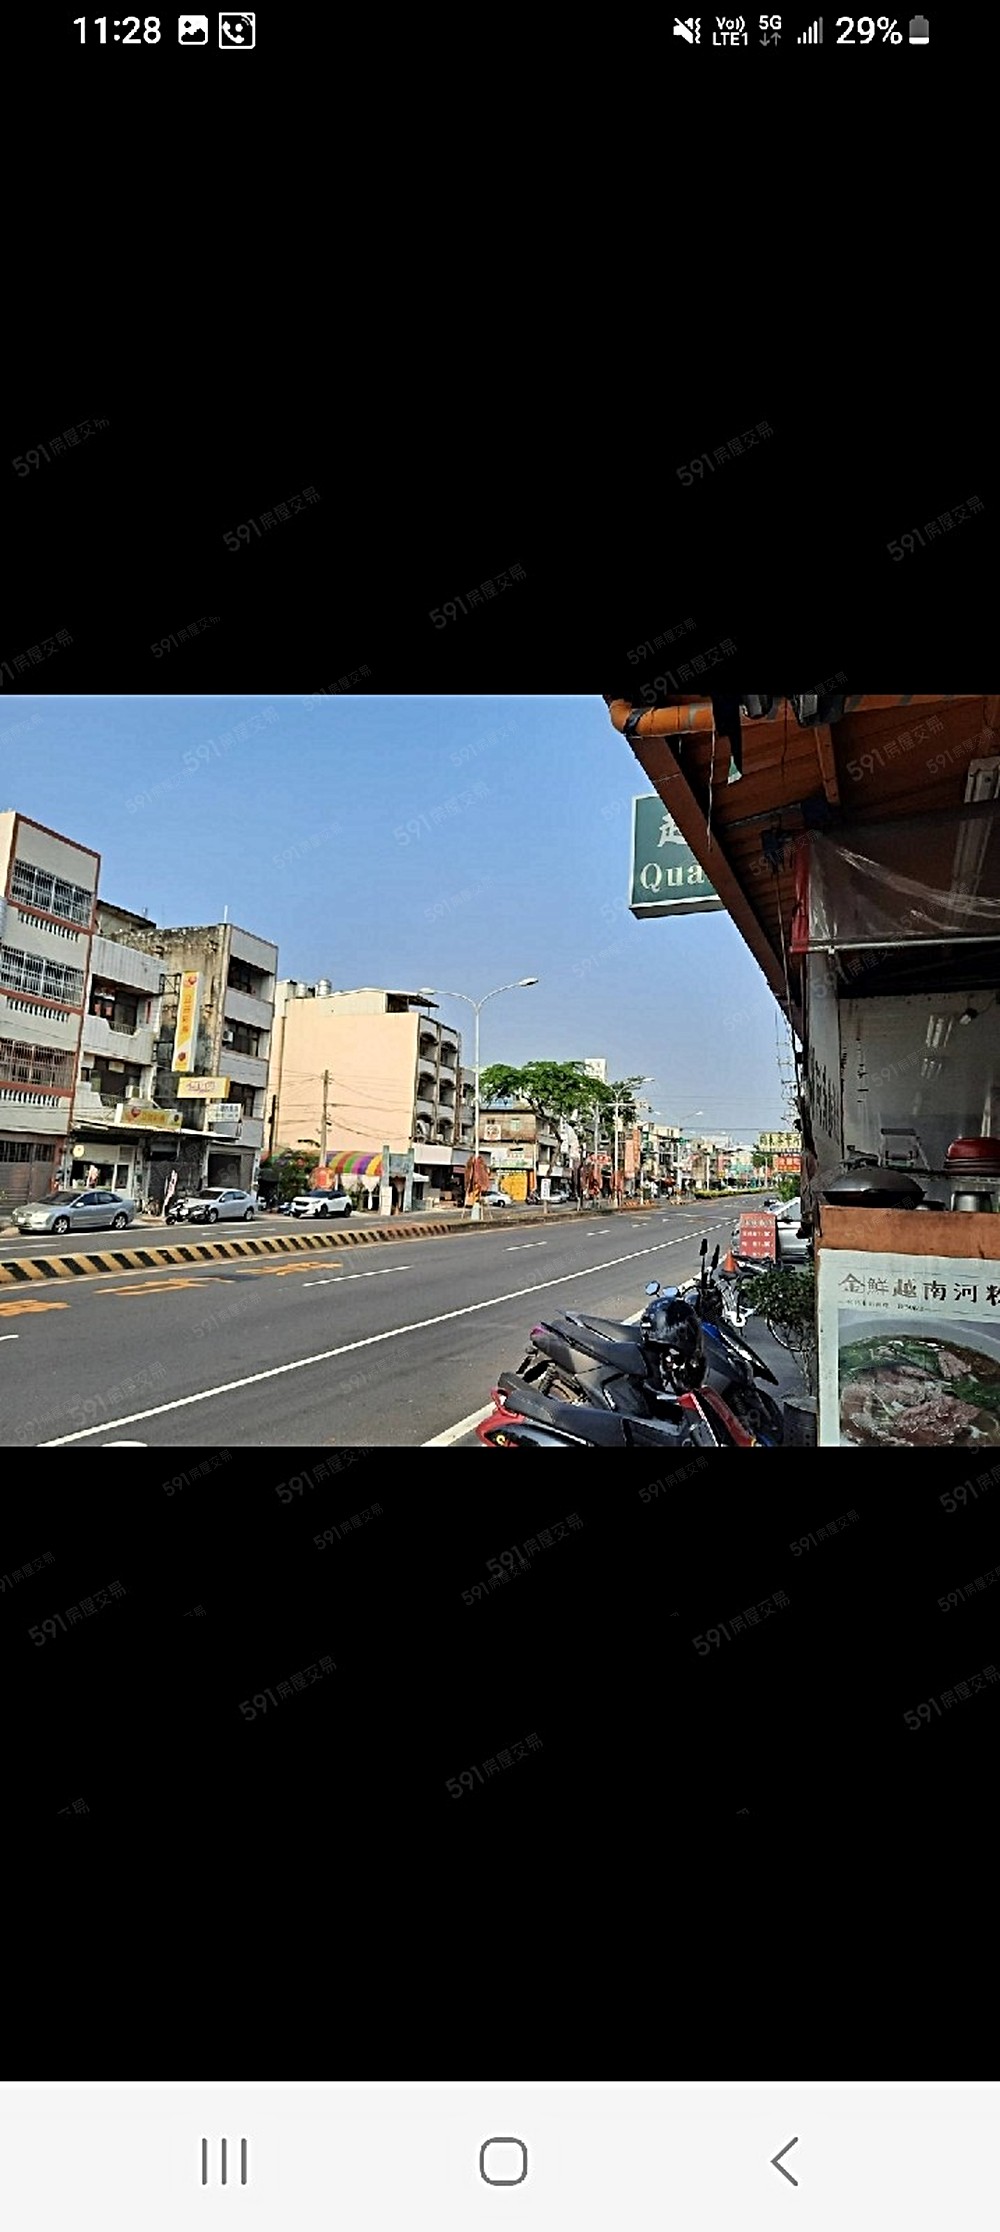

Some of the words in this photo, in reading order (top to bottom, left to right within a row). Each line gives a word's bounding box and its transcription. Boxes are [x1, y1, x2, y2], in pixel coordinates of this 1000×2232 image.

[73, 16, 161, 44] 11:28
[759, 15, 782, 30] 5G
[835, 16, 903, 45] 29%
[712, 31, 748, 46] LTE1
[640, 863, 710, 893] Qua
